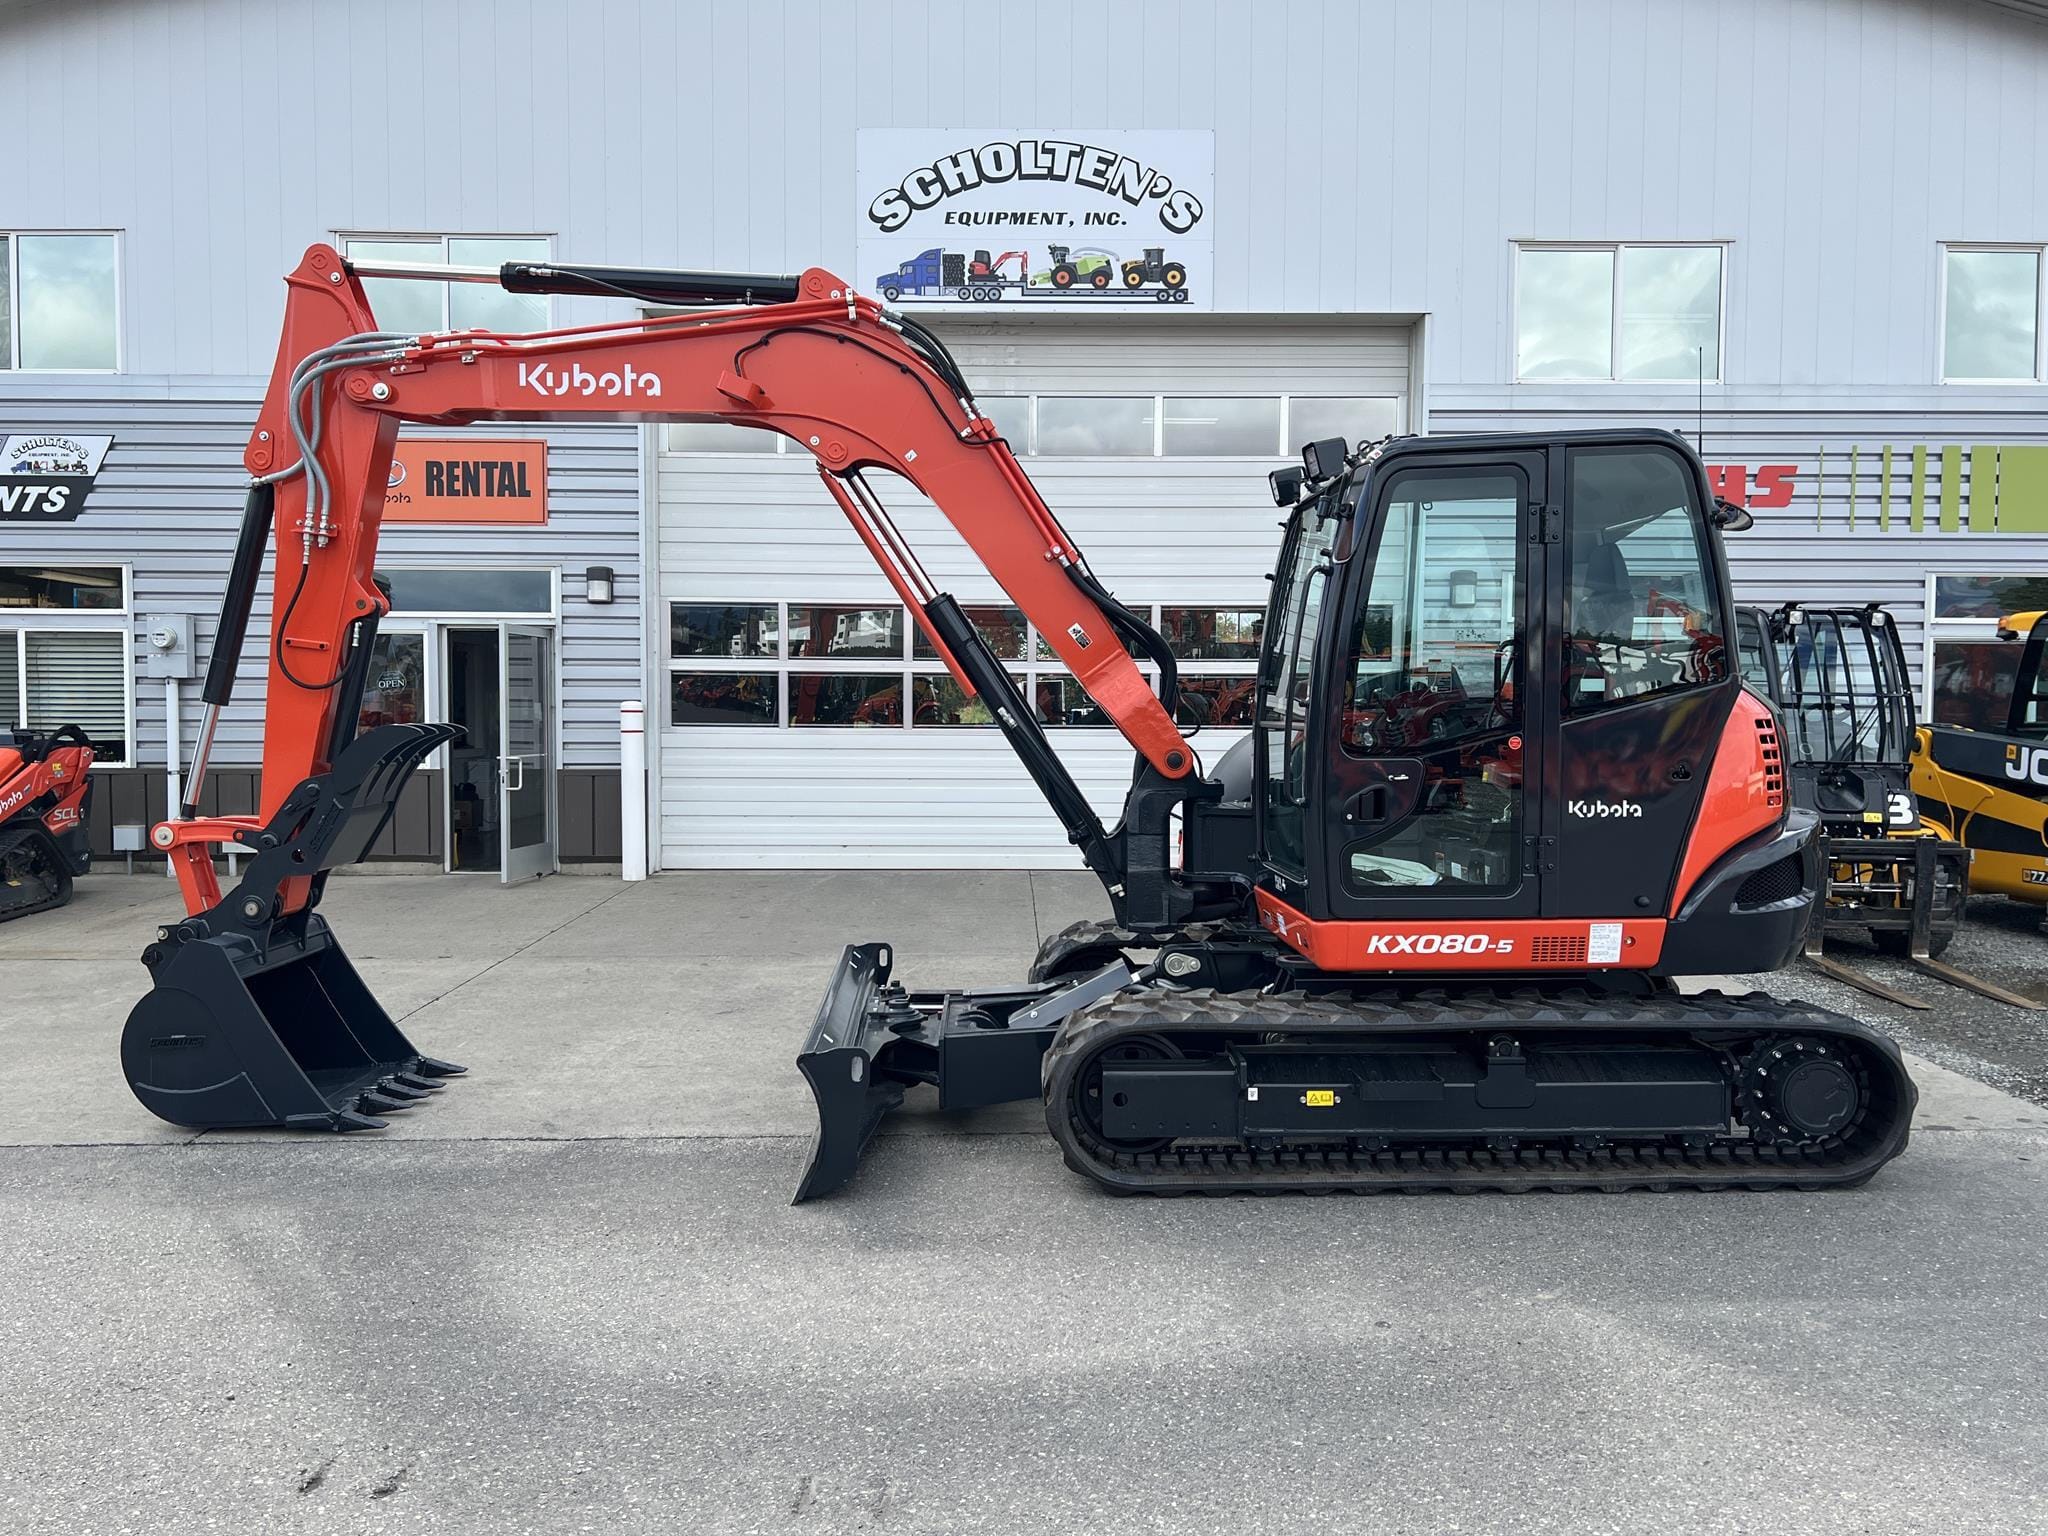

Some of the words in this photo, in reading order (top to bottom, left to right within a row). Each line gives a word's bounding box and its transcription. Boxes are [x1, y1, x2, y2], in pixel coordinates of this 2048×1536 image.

[868, 140, 1204, 234] SCHOLTEN'S
[944, 211, 1075, 228] EQUIPMENT,
[1084, 211, 1128, 226] INC.
[519, 363, 661, 396] Kubota
[425, 460, 532, 498] RENTAL
[378, 679, 405, 689] OPEN
[53, 807, 77, 821] SCL
[1568, 799, 1643, 818] Kubota
[2030, 870, 2048, 883] 77
[1366, 934, 1515, 954] KX080-5
